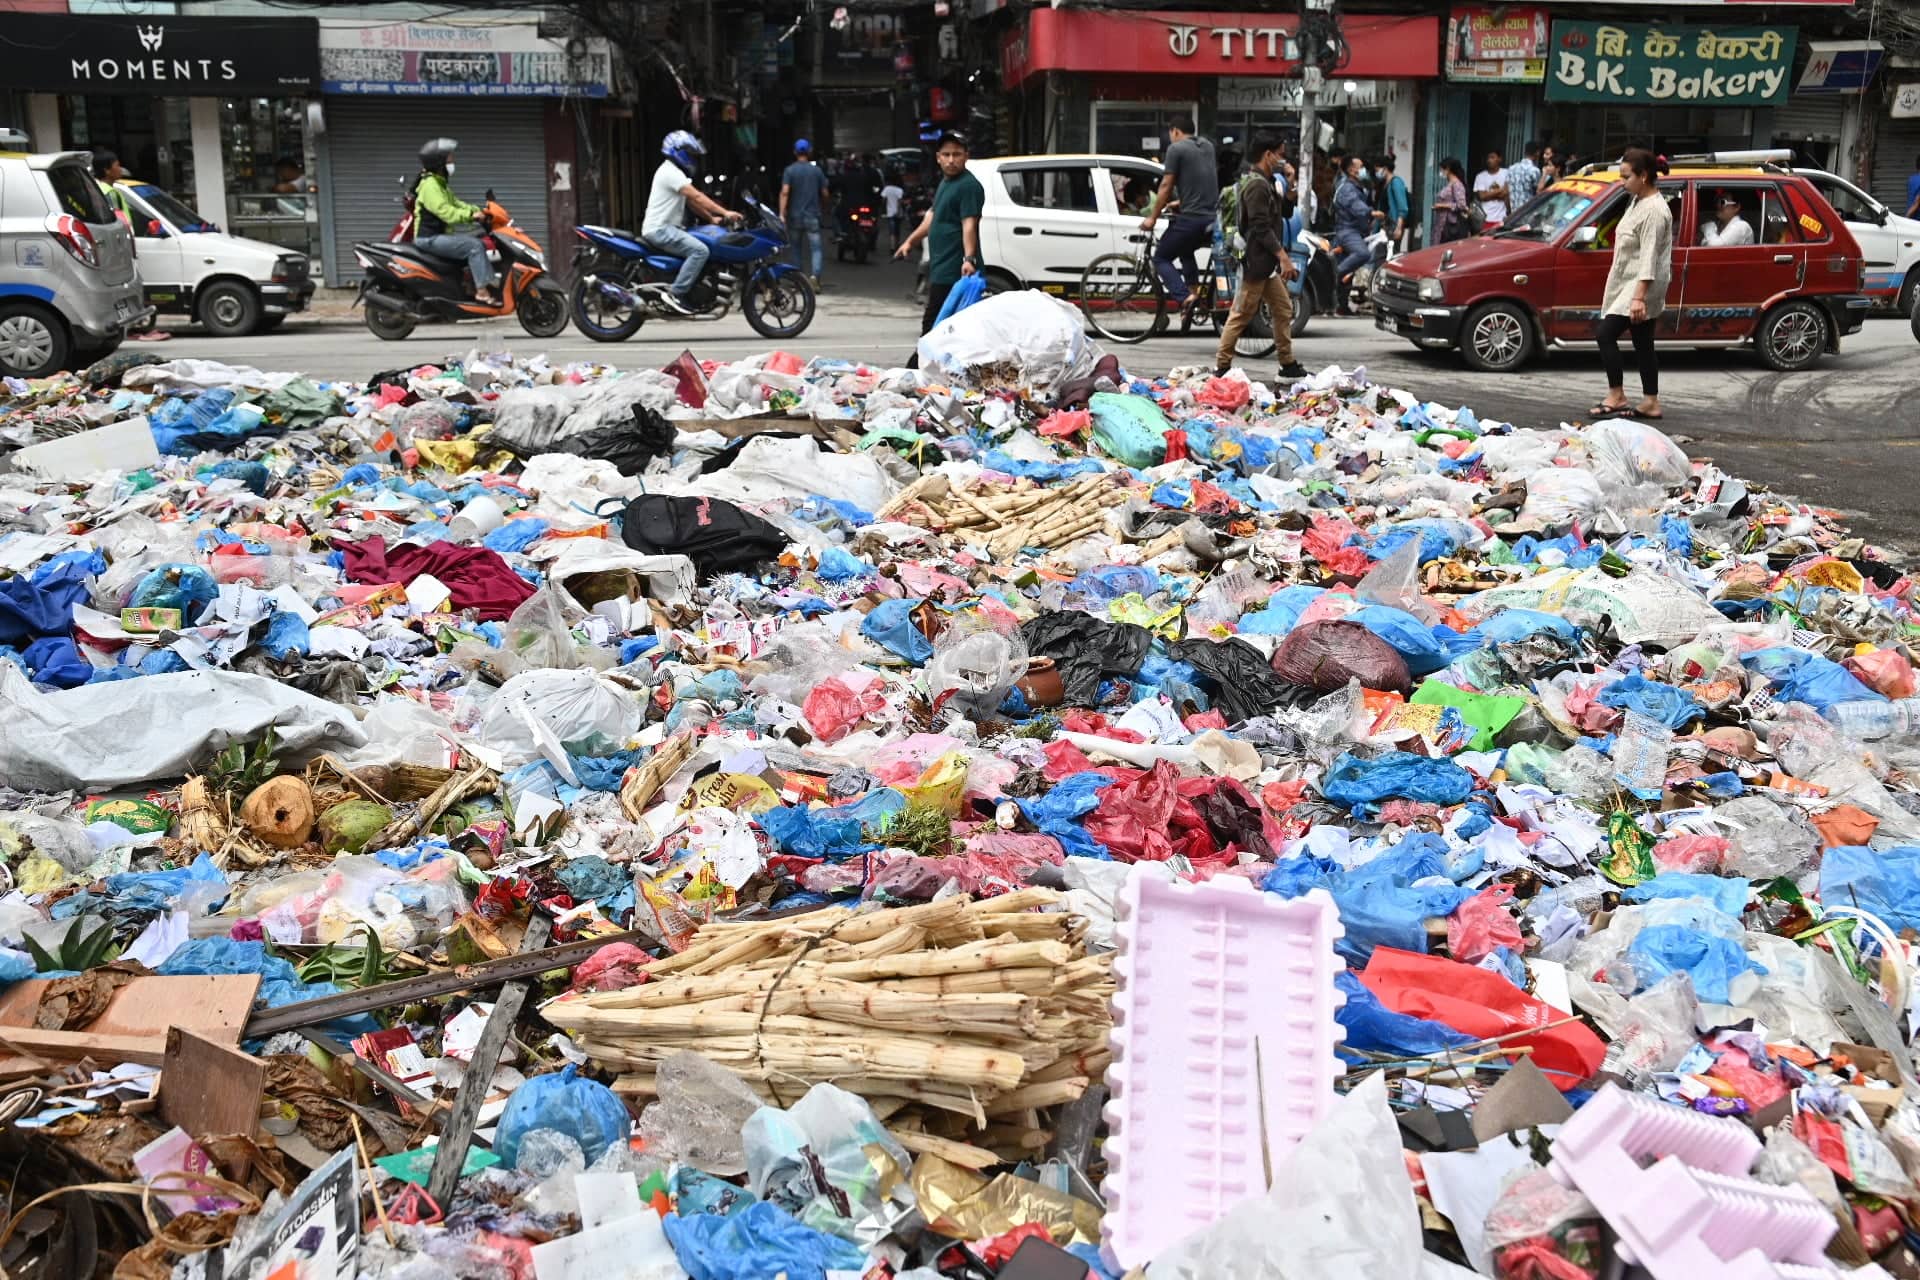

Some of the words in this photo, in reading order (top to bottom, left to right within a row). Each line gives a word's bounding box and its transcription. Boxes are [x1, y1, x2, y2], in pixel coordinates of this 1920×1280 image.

[1210, 27, 1342, 58] TIT
[1696, 29, 1784, 61] बेकरी
[72, 59, 236, 80] MOMENTS
[1555, 51, 1636, 96] B.K.
[1646, 65, 1785, 99] Bakery
[700, 772, 731, 803] Fresh
